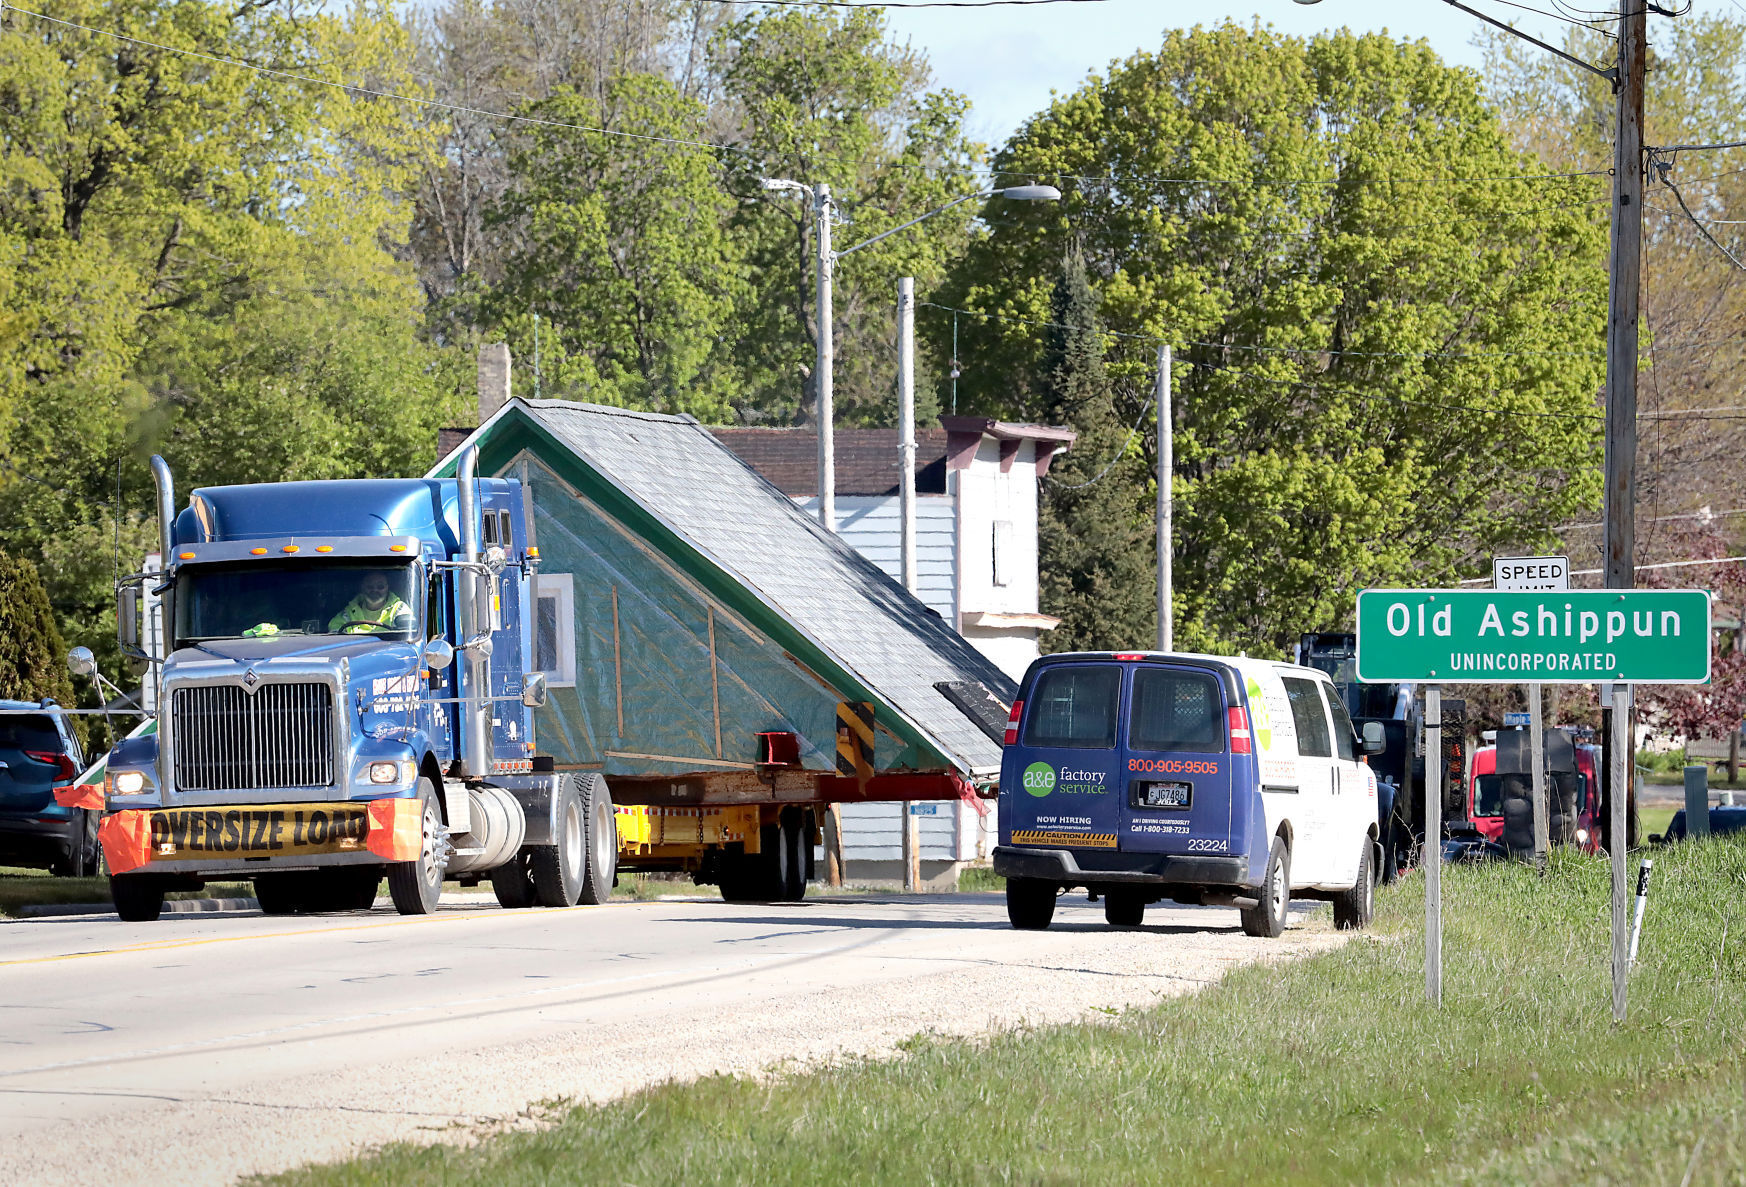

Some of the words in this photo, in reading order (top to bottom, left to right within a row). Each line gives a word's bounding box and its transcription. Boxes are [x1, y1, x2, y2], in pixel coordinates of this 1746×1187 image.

[1501, 564, 1562, 580] SPEED
[1386, 602, 1452, 637] Old
[1477, 603, 1681, 643] Ashippun
[1450, 653, 1617, 671] UNINCORPORATED
[1024, 771, 1055, 788] a&e
[1060, 766, 1106, 785] factory
[1060, 781, 1106, 794] service
[1036, 816, 1057, 824] NOW
[1059, 816, 1092, 825] HIRING
[151, 810, 285, 852] OVERSIZE
[293, 810, 368, 846] LOAD
[1187, 839, 1228, 852] 23224
